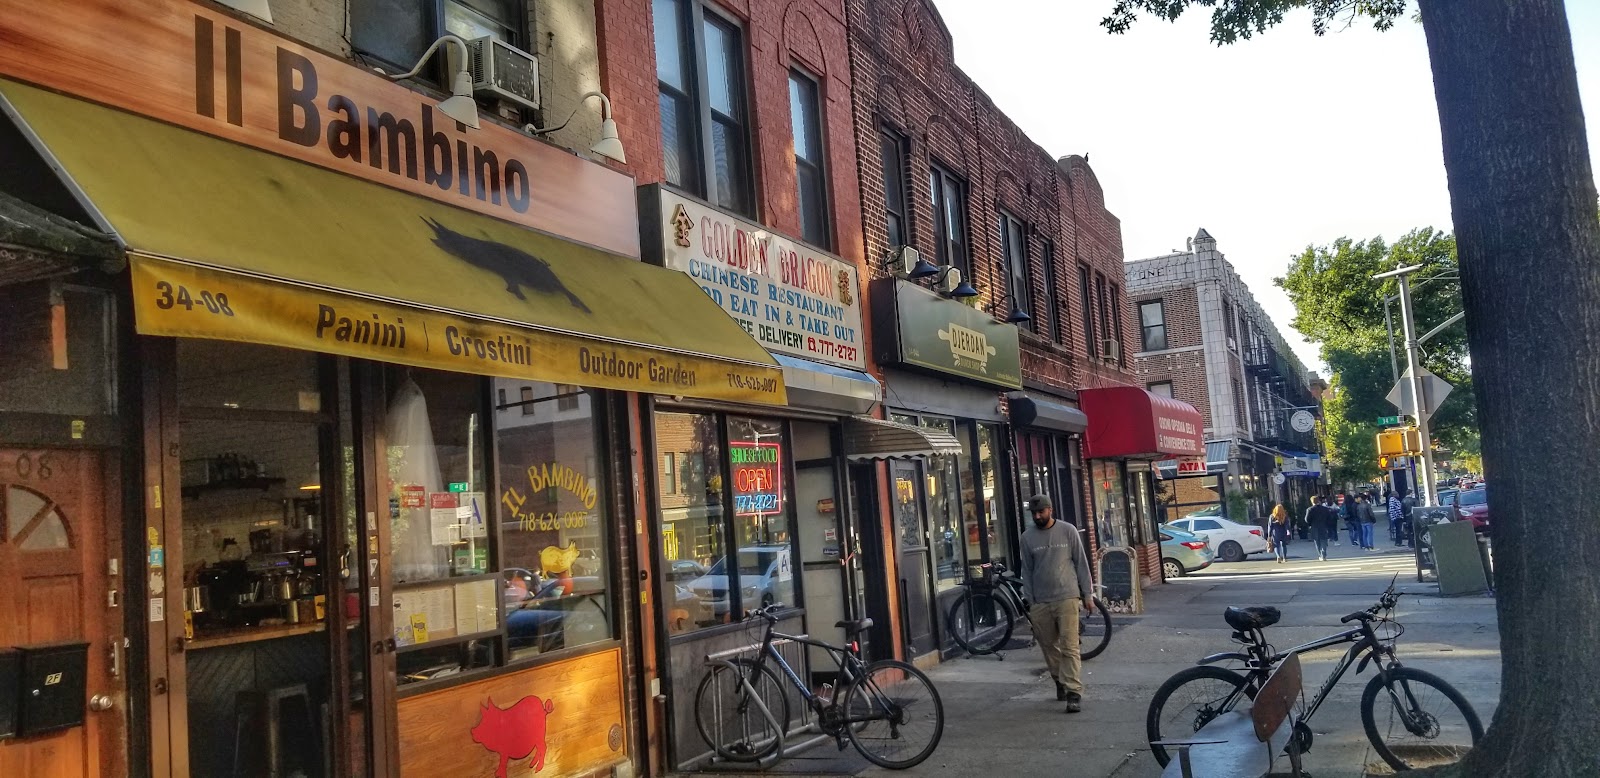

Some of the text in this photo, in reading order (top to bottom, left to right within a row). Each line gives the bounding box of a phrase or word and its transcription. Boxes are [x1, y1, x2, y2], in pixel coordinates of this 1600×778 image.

[276, 46, 530, 214] Bambino
[701, 215, 833, 300] GOLDEN DRAGON
[156, 280, 234, 317] 34-08
[689, 258, 845, 322] CHINESE RESTAURANT
[730, 293, 759, 317] EAT
[765, 303, 781, 323] IN
[785, 310, 794, 326] &
[799, 314, 830, 336] TAKE
[834, 325, 855, 343] OUT
[316, 303, 407, 350] Panini
[445, 325, 533, 367] Crostini
[579, 346, 644, 381] Outdoor
[648, 357, 697, 388] Garden
[759, 323, 804, 350] DELIVERY
[952, 327, 985, 356] DJERDAN
[738, 468, 773, 492] OPEN
[1178, 462, 1206, 472] ATM
[501, 486, 527, 518] IL
[527, 462, 598, 510] BAMBINO
[518, 511, 588, 532] 718-626-0087
[781, 553, 789, 573] A
